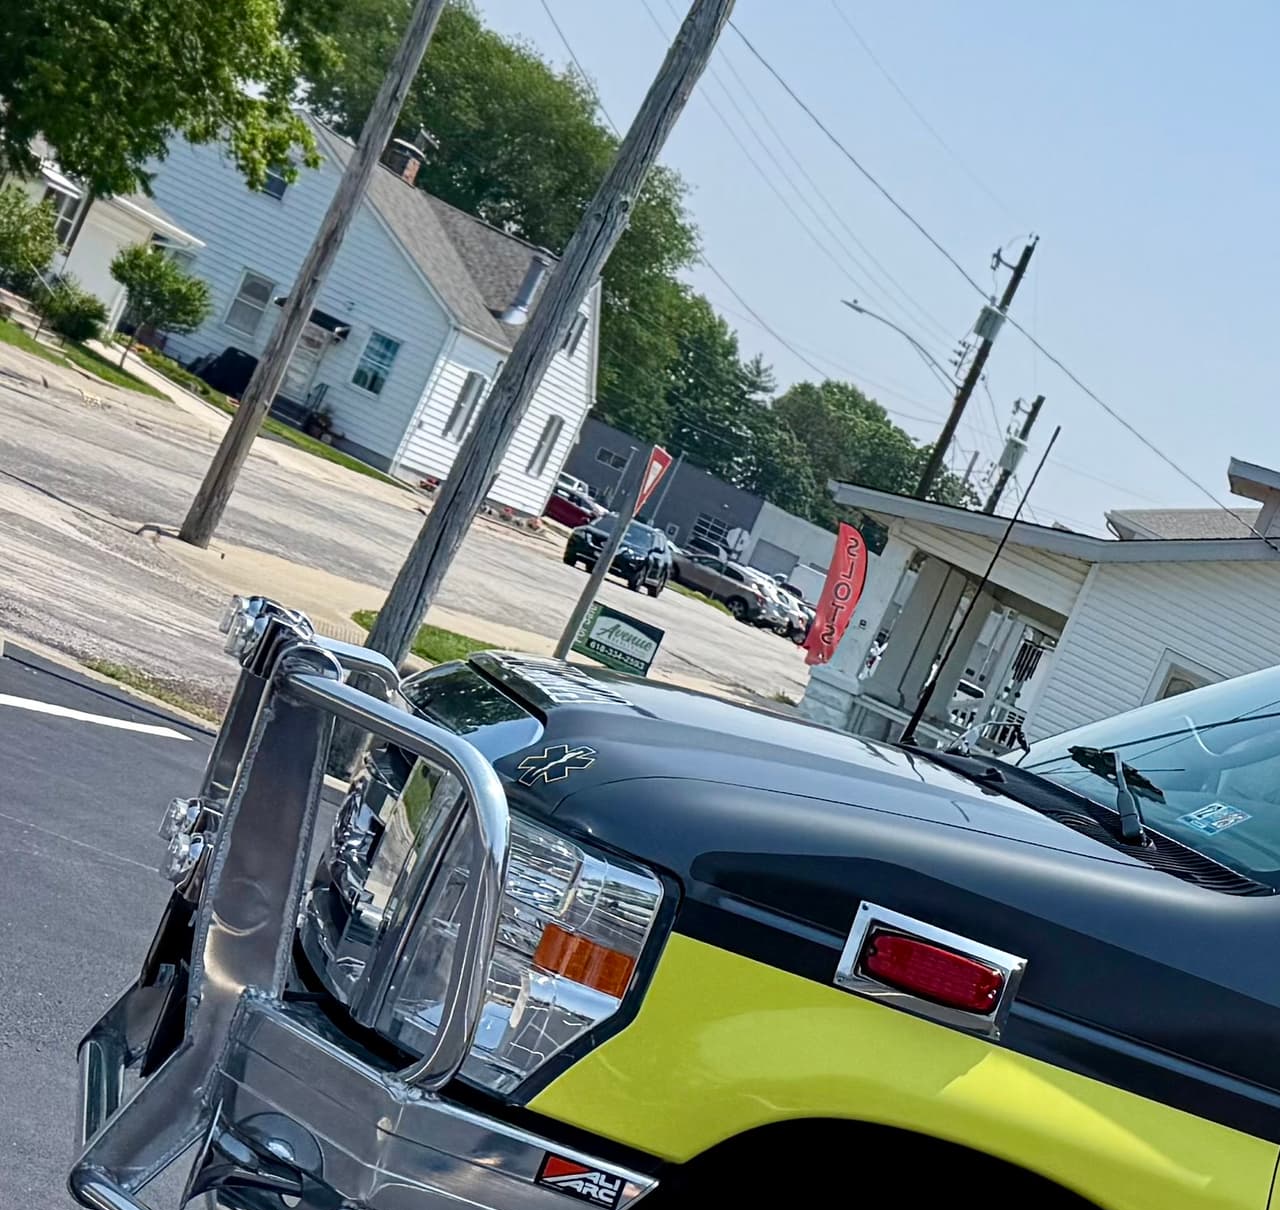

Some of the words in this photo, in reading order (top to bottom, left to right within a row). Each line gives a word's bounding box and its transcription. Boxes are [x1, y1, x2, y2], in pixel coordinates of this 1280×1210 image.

[596, 623, 653, 652] Avenue
[555, 1171, 621, 1192] ALI
[559, 1180, 618, 1204] ARC
